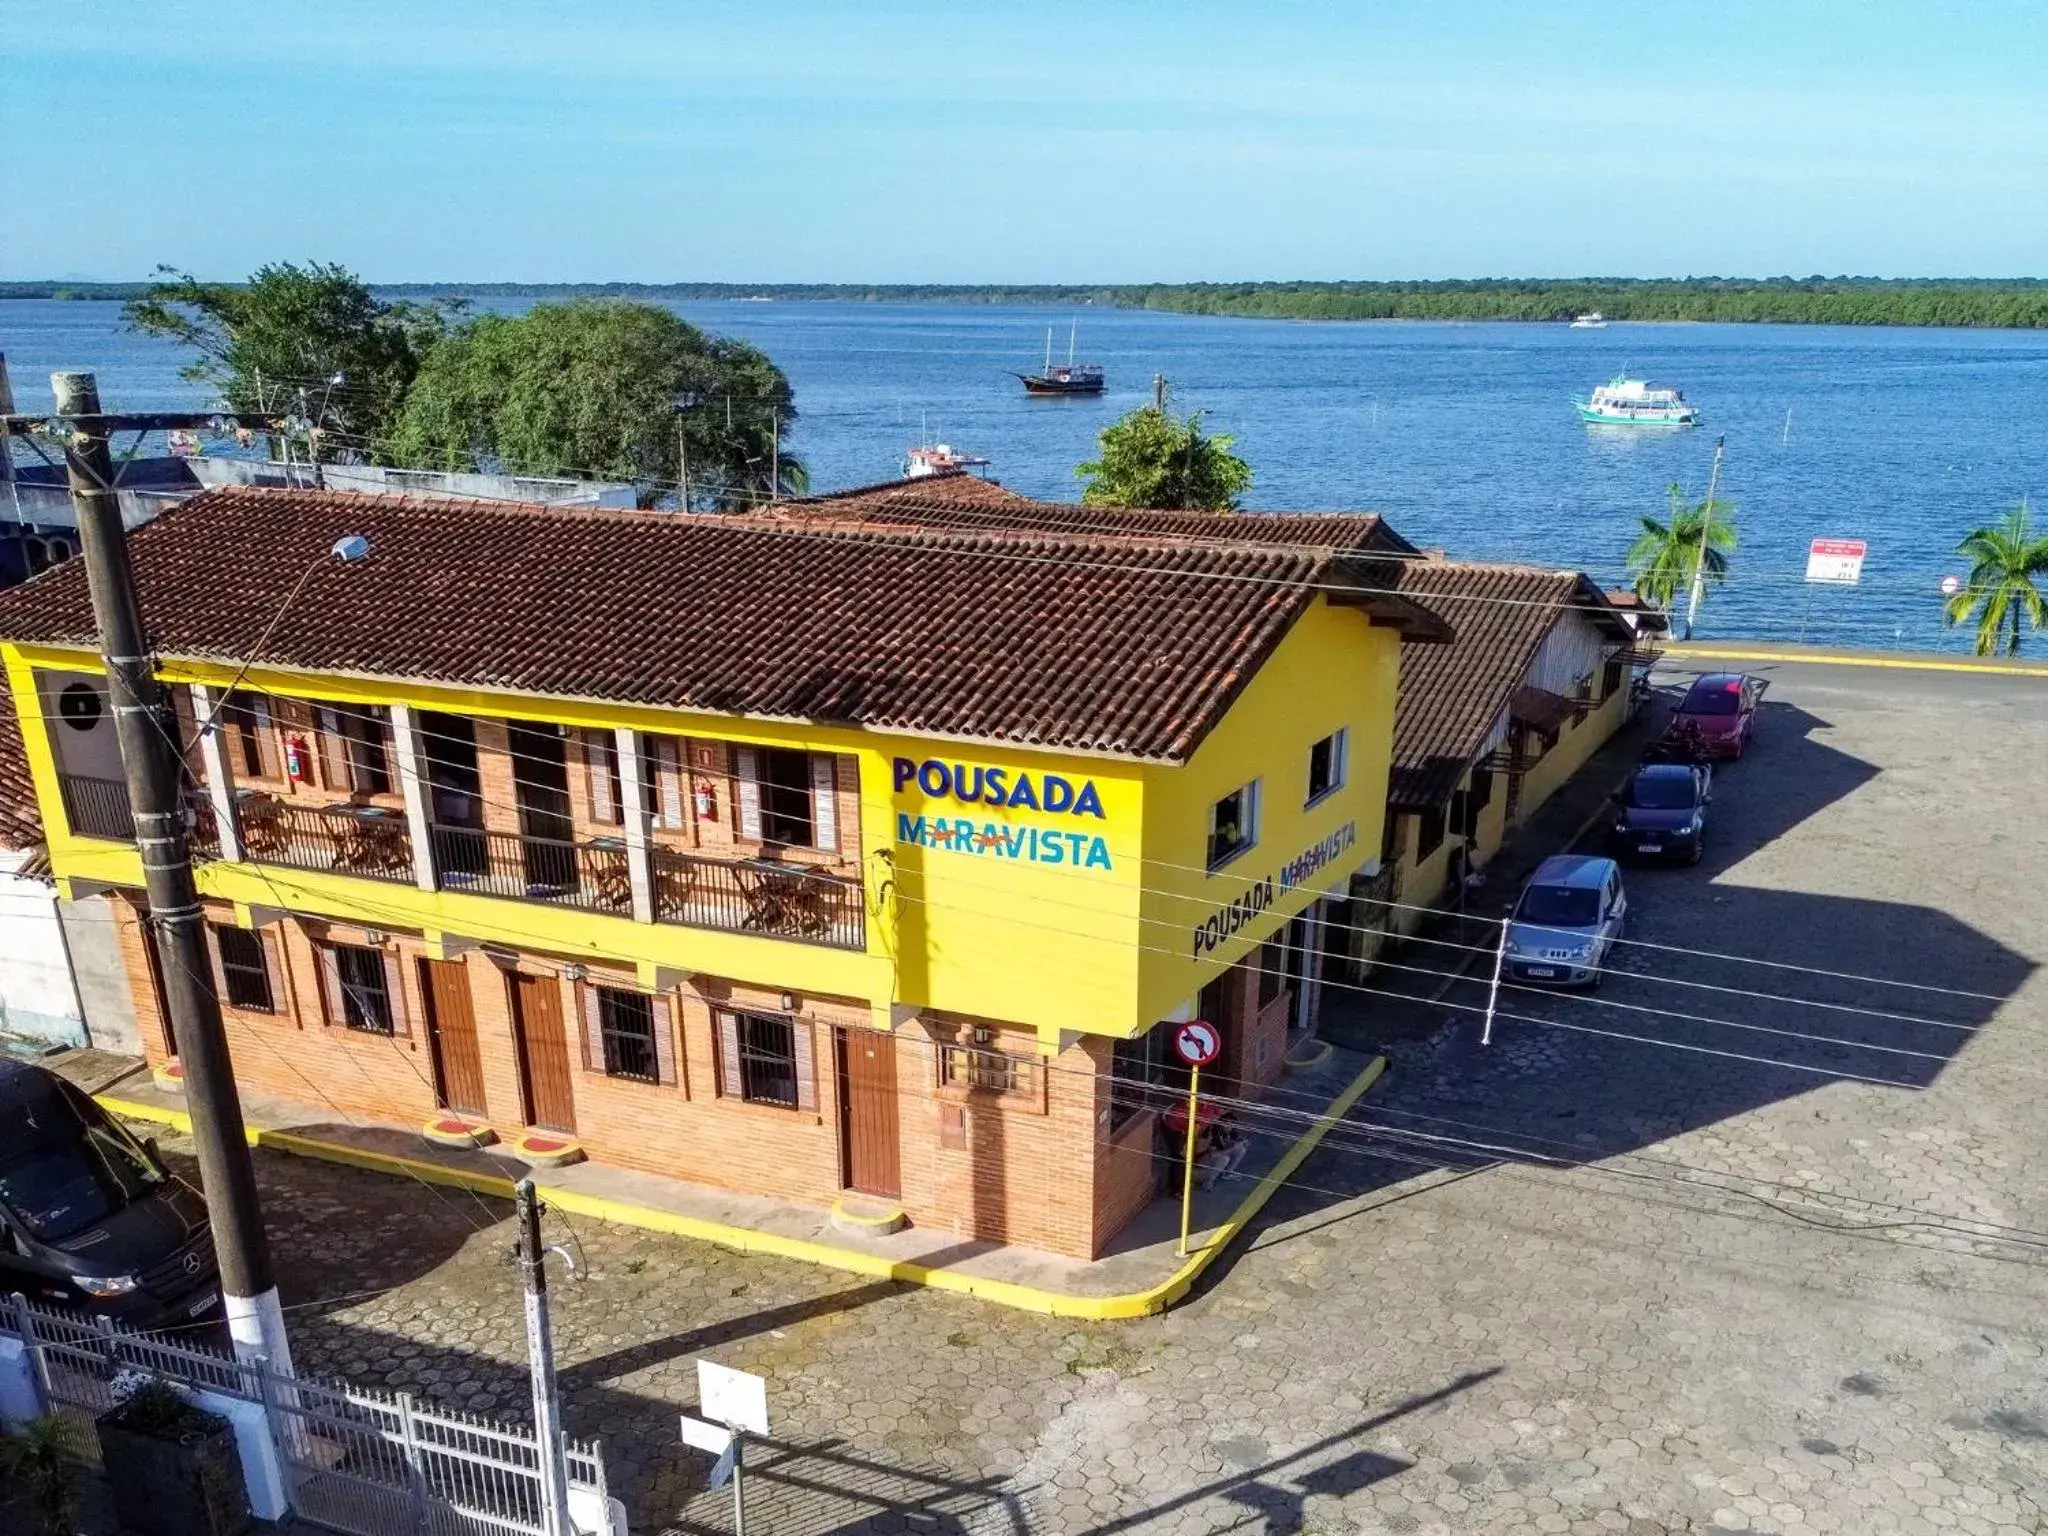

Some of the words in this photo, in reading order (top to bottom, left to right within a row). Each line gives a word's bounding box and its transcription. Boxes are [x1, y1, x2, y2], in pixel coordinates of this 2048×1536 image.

[893, 757, 1106, 819] POUSADA
[898, 813, 1112, 870] MARAVISTA
[1194, 875, 1274, 962] POUSADA
[1280, 821, 1356, 897] MARAVISTA
